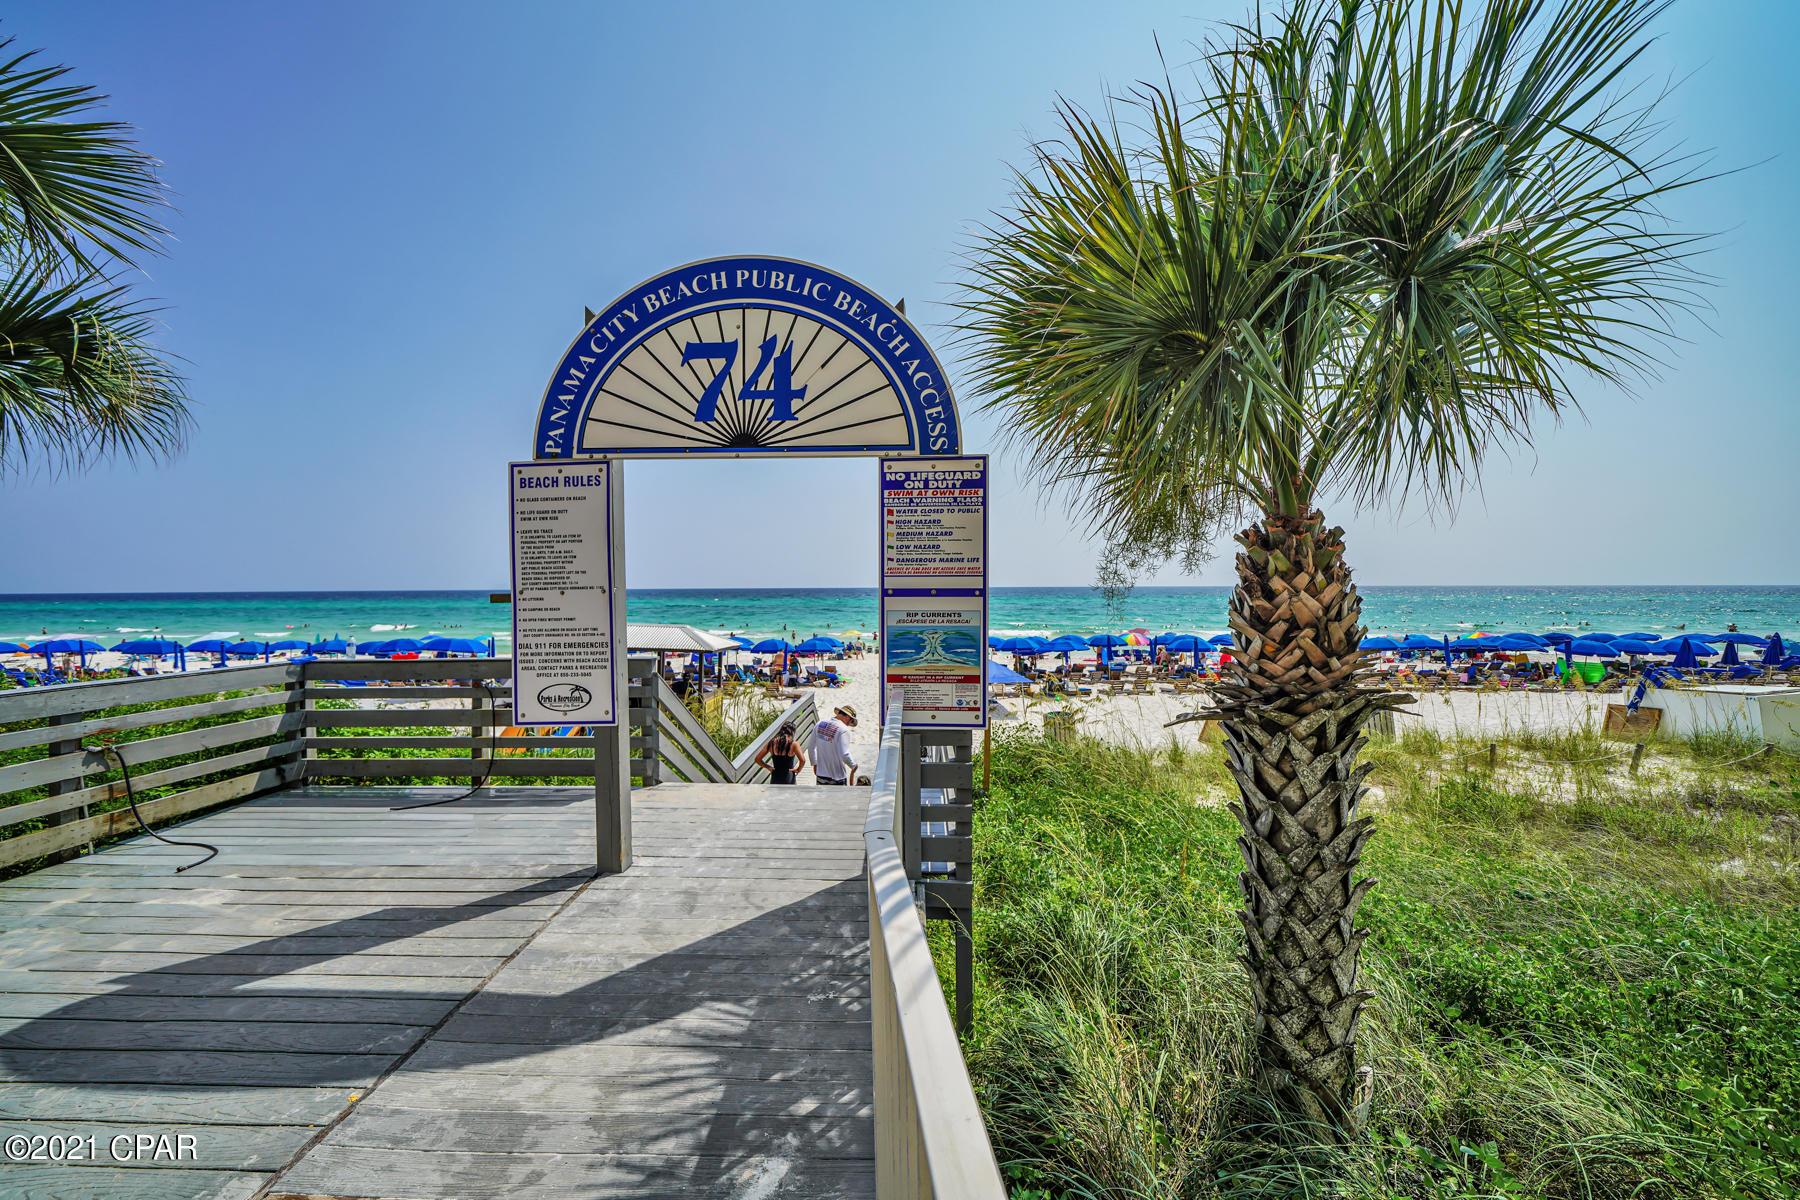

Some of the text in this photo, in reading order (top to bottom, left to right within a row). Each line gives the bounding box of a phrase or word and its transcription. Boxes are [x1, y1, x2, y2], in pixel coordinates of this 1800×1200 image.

[544, 269, 949, 454] PANAMA CITY BEACH PUBLIC BEACH ACCESS
[680, 333, 808, 422] 74
[520, 475, 601, 488] BEACH RULES
[910, 472, 981, 480] LIFEGUARD
[929, 480, 963, 488] DUTY
